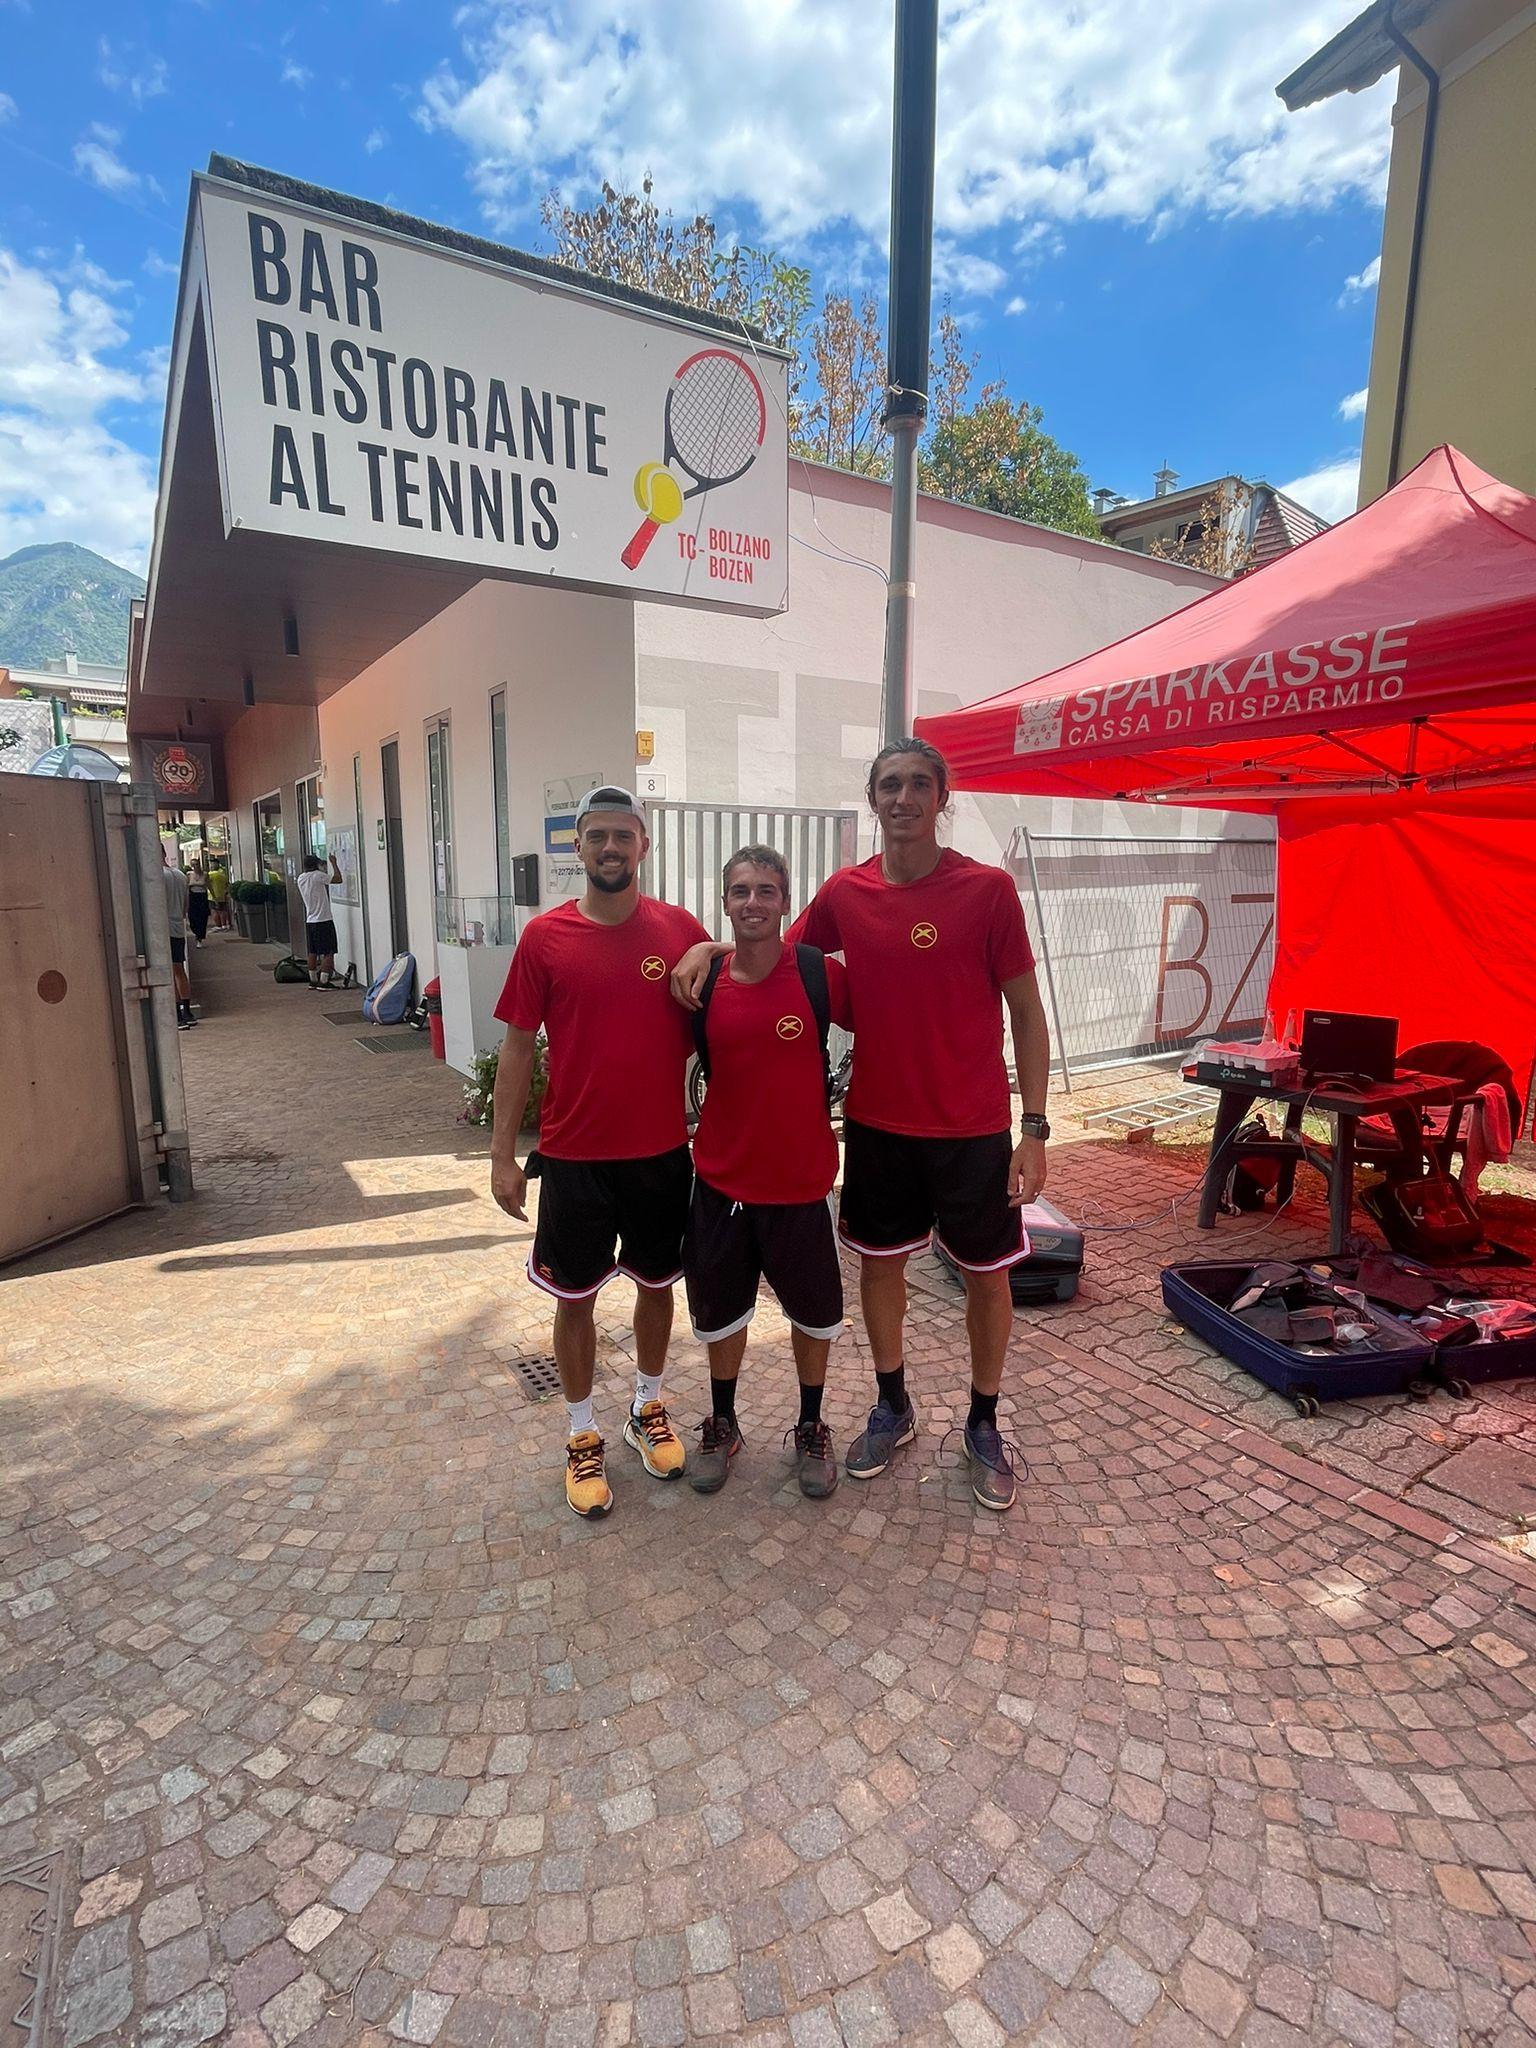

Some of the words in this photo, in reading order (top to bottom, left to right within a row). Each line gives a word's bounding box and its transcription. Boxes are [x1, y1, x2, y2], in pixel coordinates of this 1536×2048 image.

[247, 211, 382, 332] BAR
[256, 319, 608, 477] RISTORANTE
[269, 424, 346, 516] AL
[358, 441, 558, 551] TENNIS
[709, 527, 770, 560] BOLZANO
[709, 555, 753, 584] BOZEN
[1068, 716, 1151, 746] CASSA
[1166, 706, 1192, 730] DI
[1208, 675, 1405, 723] RISPARMIO
[1071, 620, 1418, 721] SPARKASSE
[647, 779, 656, 791] 8
